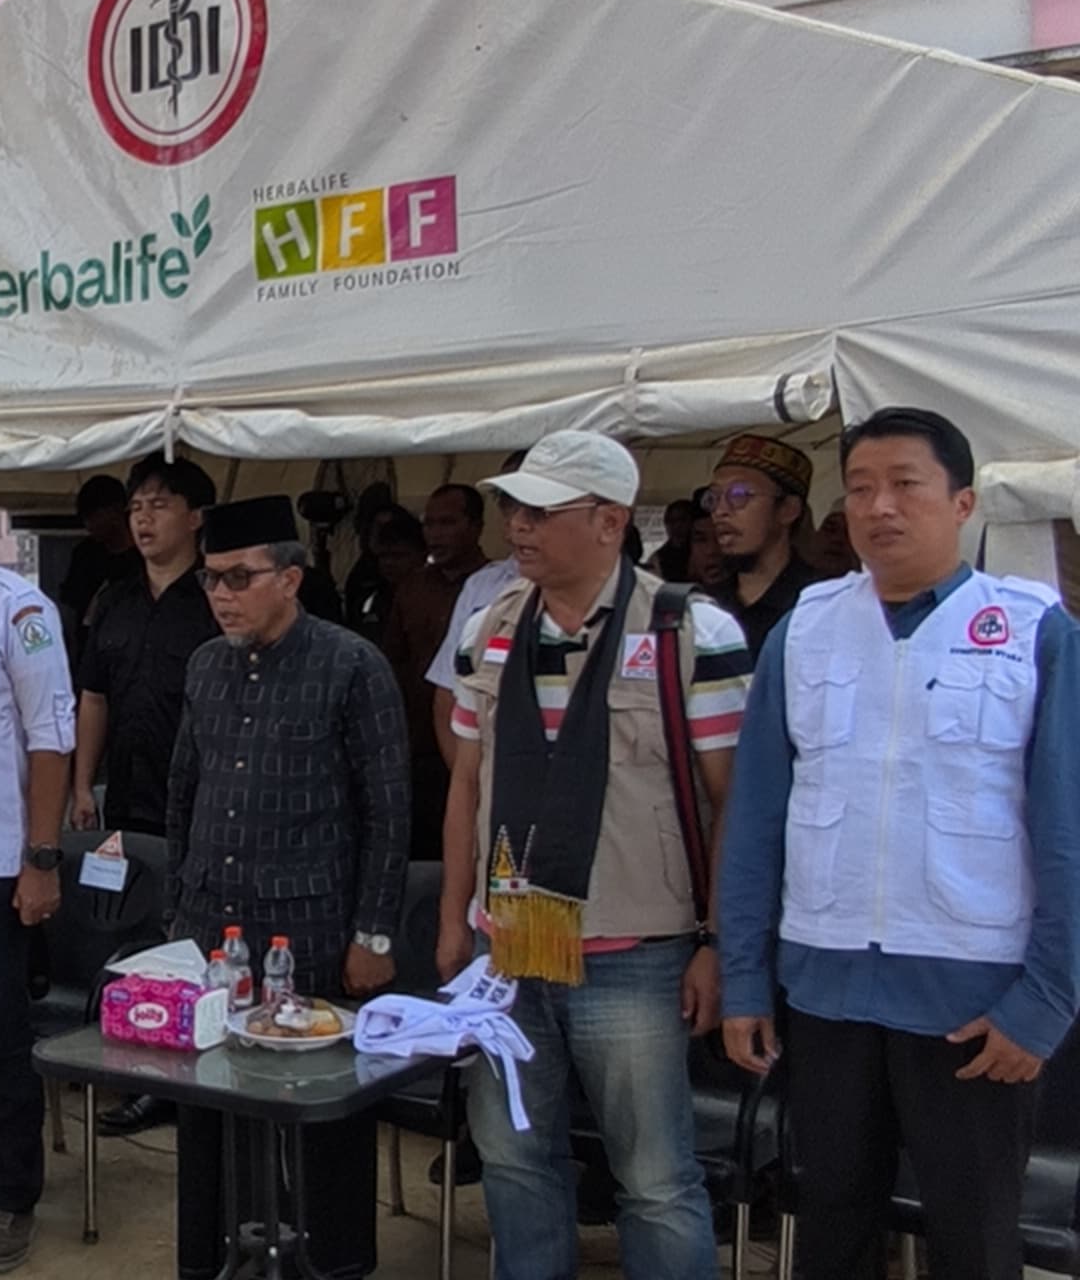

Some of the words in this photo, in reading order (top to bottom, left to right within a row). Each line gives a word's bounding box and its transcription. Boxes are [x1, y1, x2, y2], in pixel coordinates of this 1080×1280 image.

[253, 173, 350, 202] HERBALIFE
[262, 189, 438, 273] HFF
[257, 280, 318, 302] FAMILY
[333, 261, 461, 292] FOUNDATION
